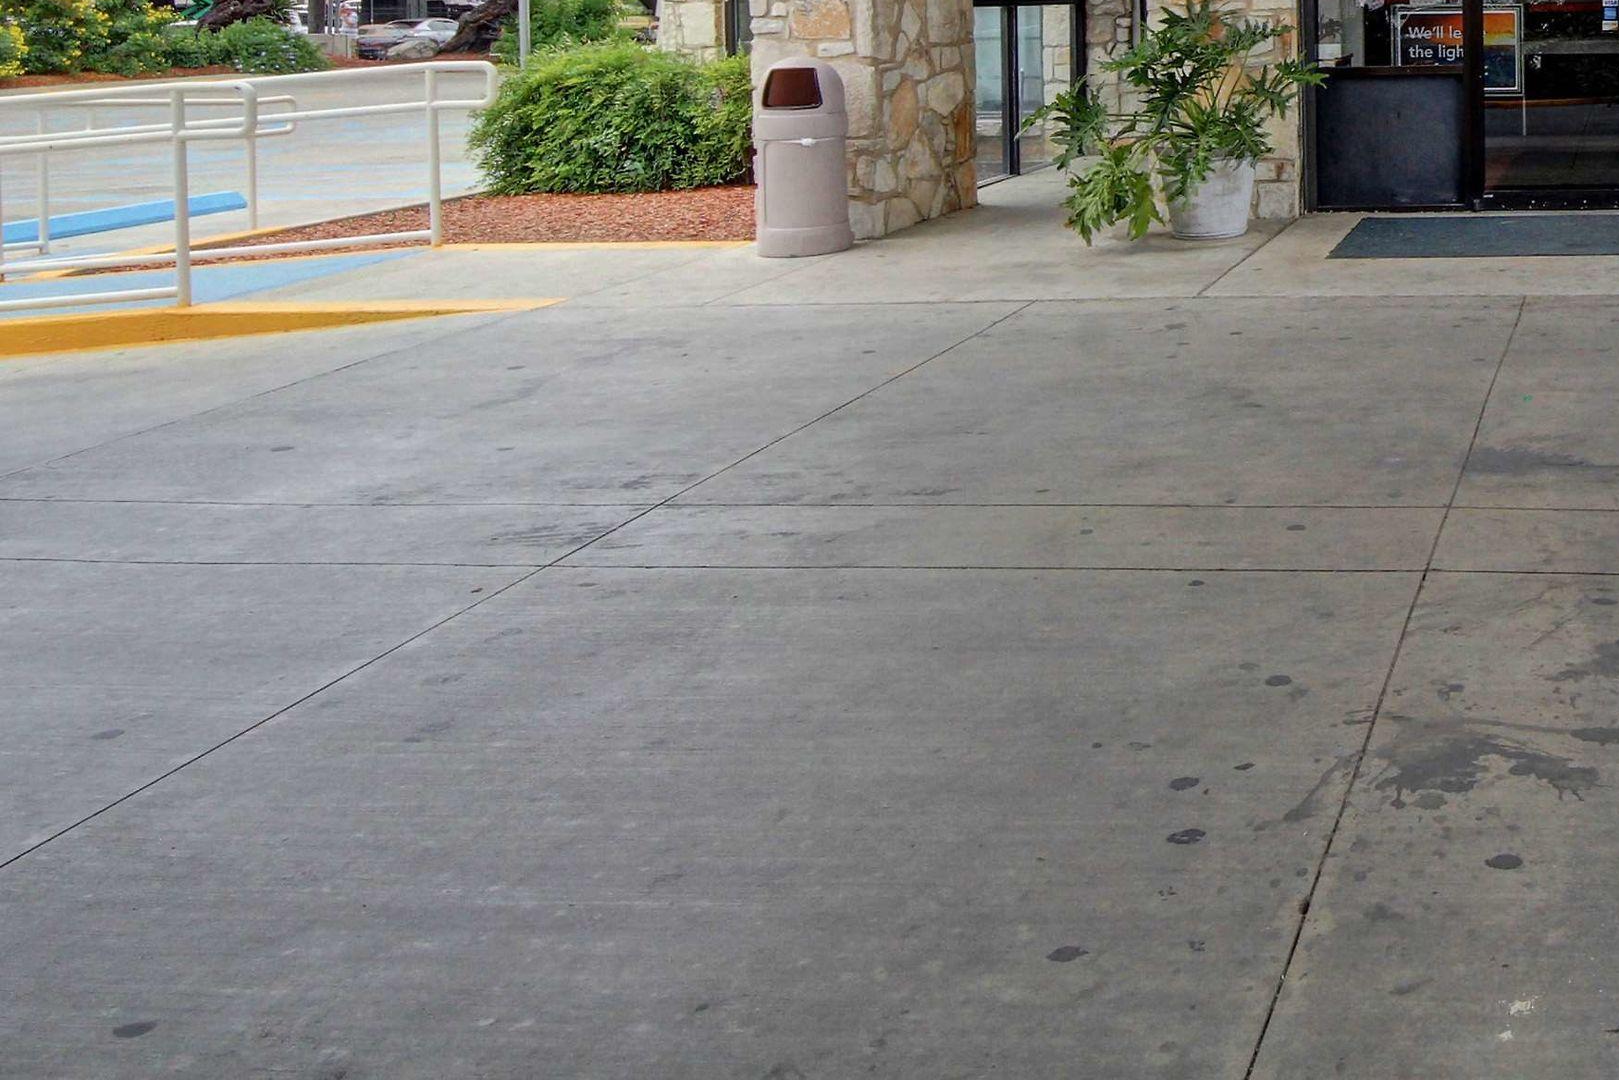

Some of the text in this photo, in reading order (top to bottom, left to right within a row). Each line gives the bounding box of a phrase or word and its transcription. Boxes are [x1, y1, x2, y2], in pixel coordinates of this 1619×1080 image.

[1408, 26, 1444, 39] We'll
[1408, 44, 1464, 61] the ligh
